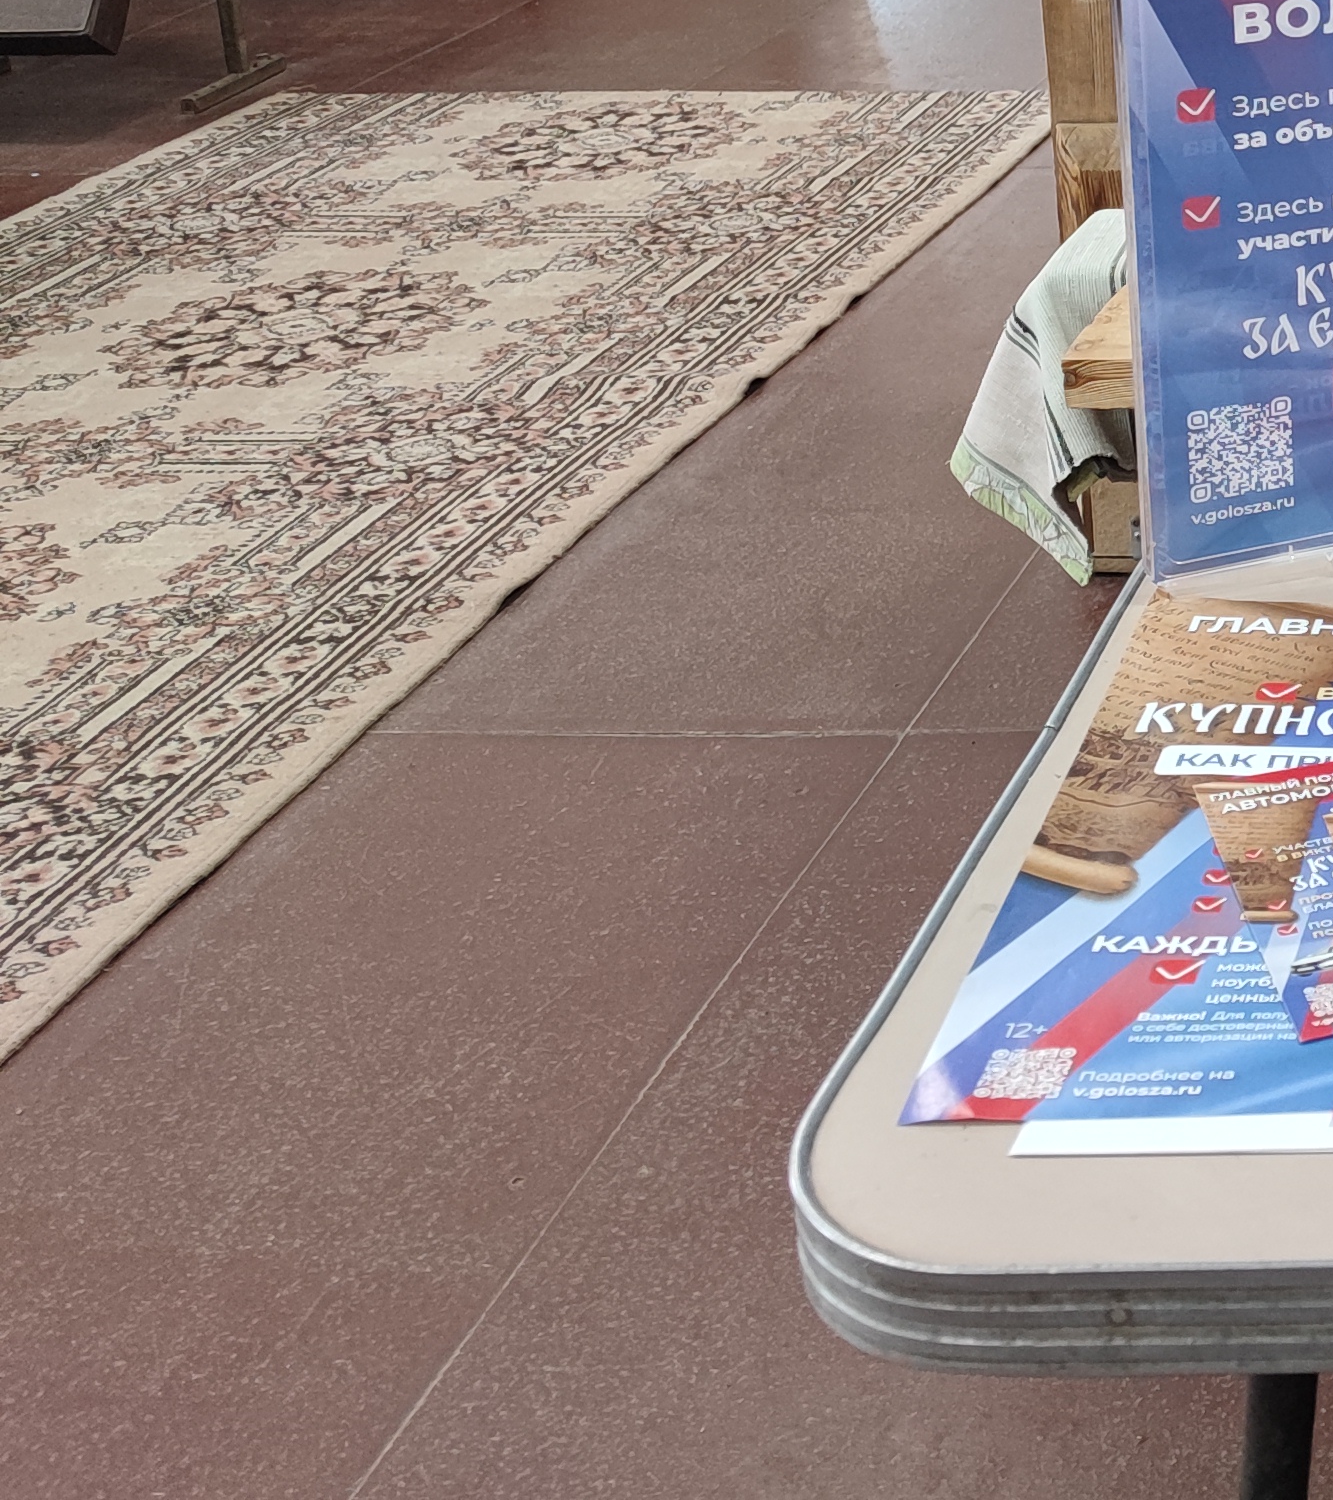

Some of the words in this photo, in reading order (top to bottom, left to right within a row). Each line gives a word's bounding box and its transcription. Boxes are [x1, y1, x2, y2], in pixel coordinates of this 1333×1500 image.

[1232, 91, 1320, 118] Здесь
[1234, 131, 1267, 150] за
[1236, 197, 1324, 224] Здесь
[1243, 313, 1299, 360] ЗА
[1190, 496, 1295, 526] v.golosza.ru
[1175, 753, 1256, 768] КАК
[1137, 1011, 1207, 1022] Важно!
[1211, 1011, 1245, 1021] Для
[1005, 1023, 1048, 1039] 12+
[1078, 1070, 1203, 1083] Подробнее
[1209, 1070, 1235, 1080] на
[1073, 1085, 1201, 1098] v.golosza.ru
